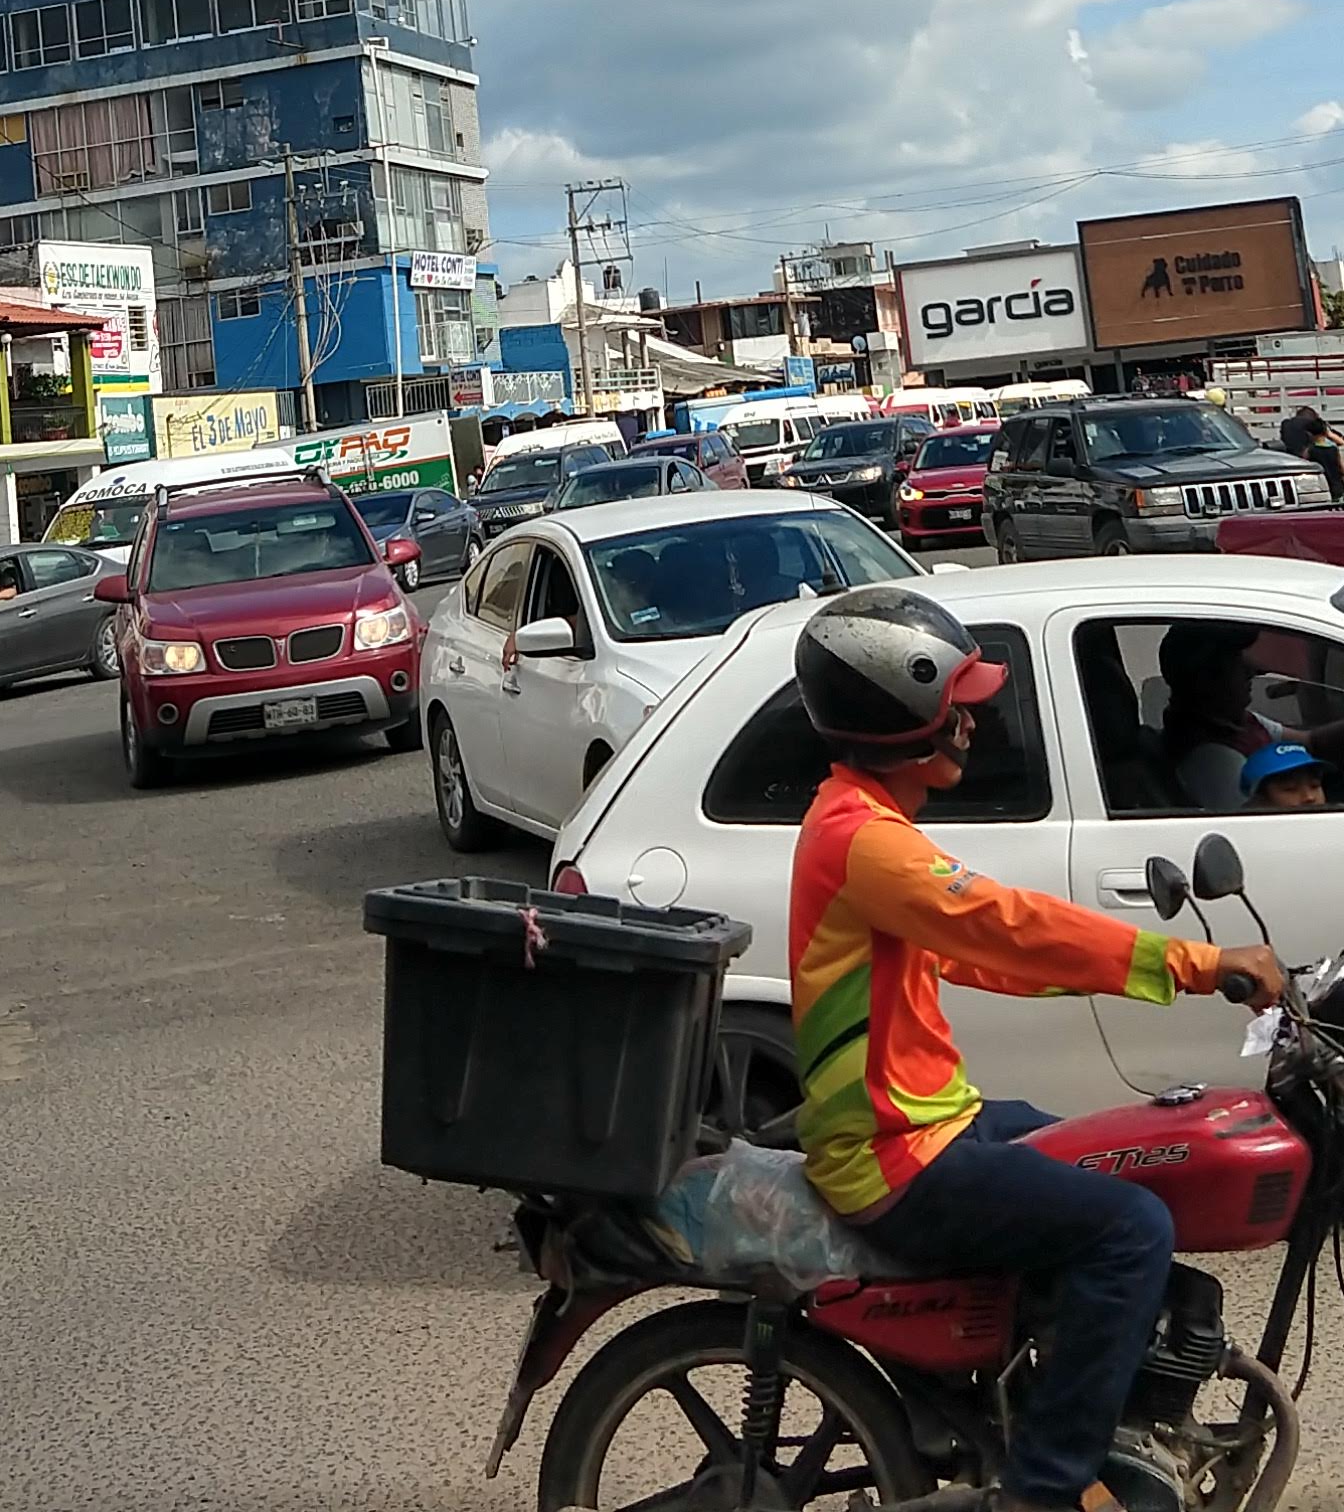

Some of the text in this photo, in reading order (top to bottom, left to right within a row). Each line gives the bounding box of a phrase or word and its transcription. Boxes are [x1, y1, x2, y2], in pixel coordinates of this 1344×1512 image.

[414, 253, 438, 272] HOTEL
[1175, 251, 1240, 274] Cuidado
[206, 415, 217, 446] 3
[218, 416, 233, 443] DE
[74, 482, 147, 503] POMOCA
